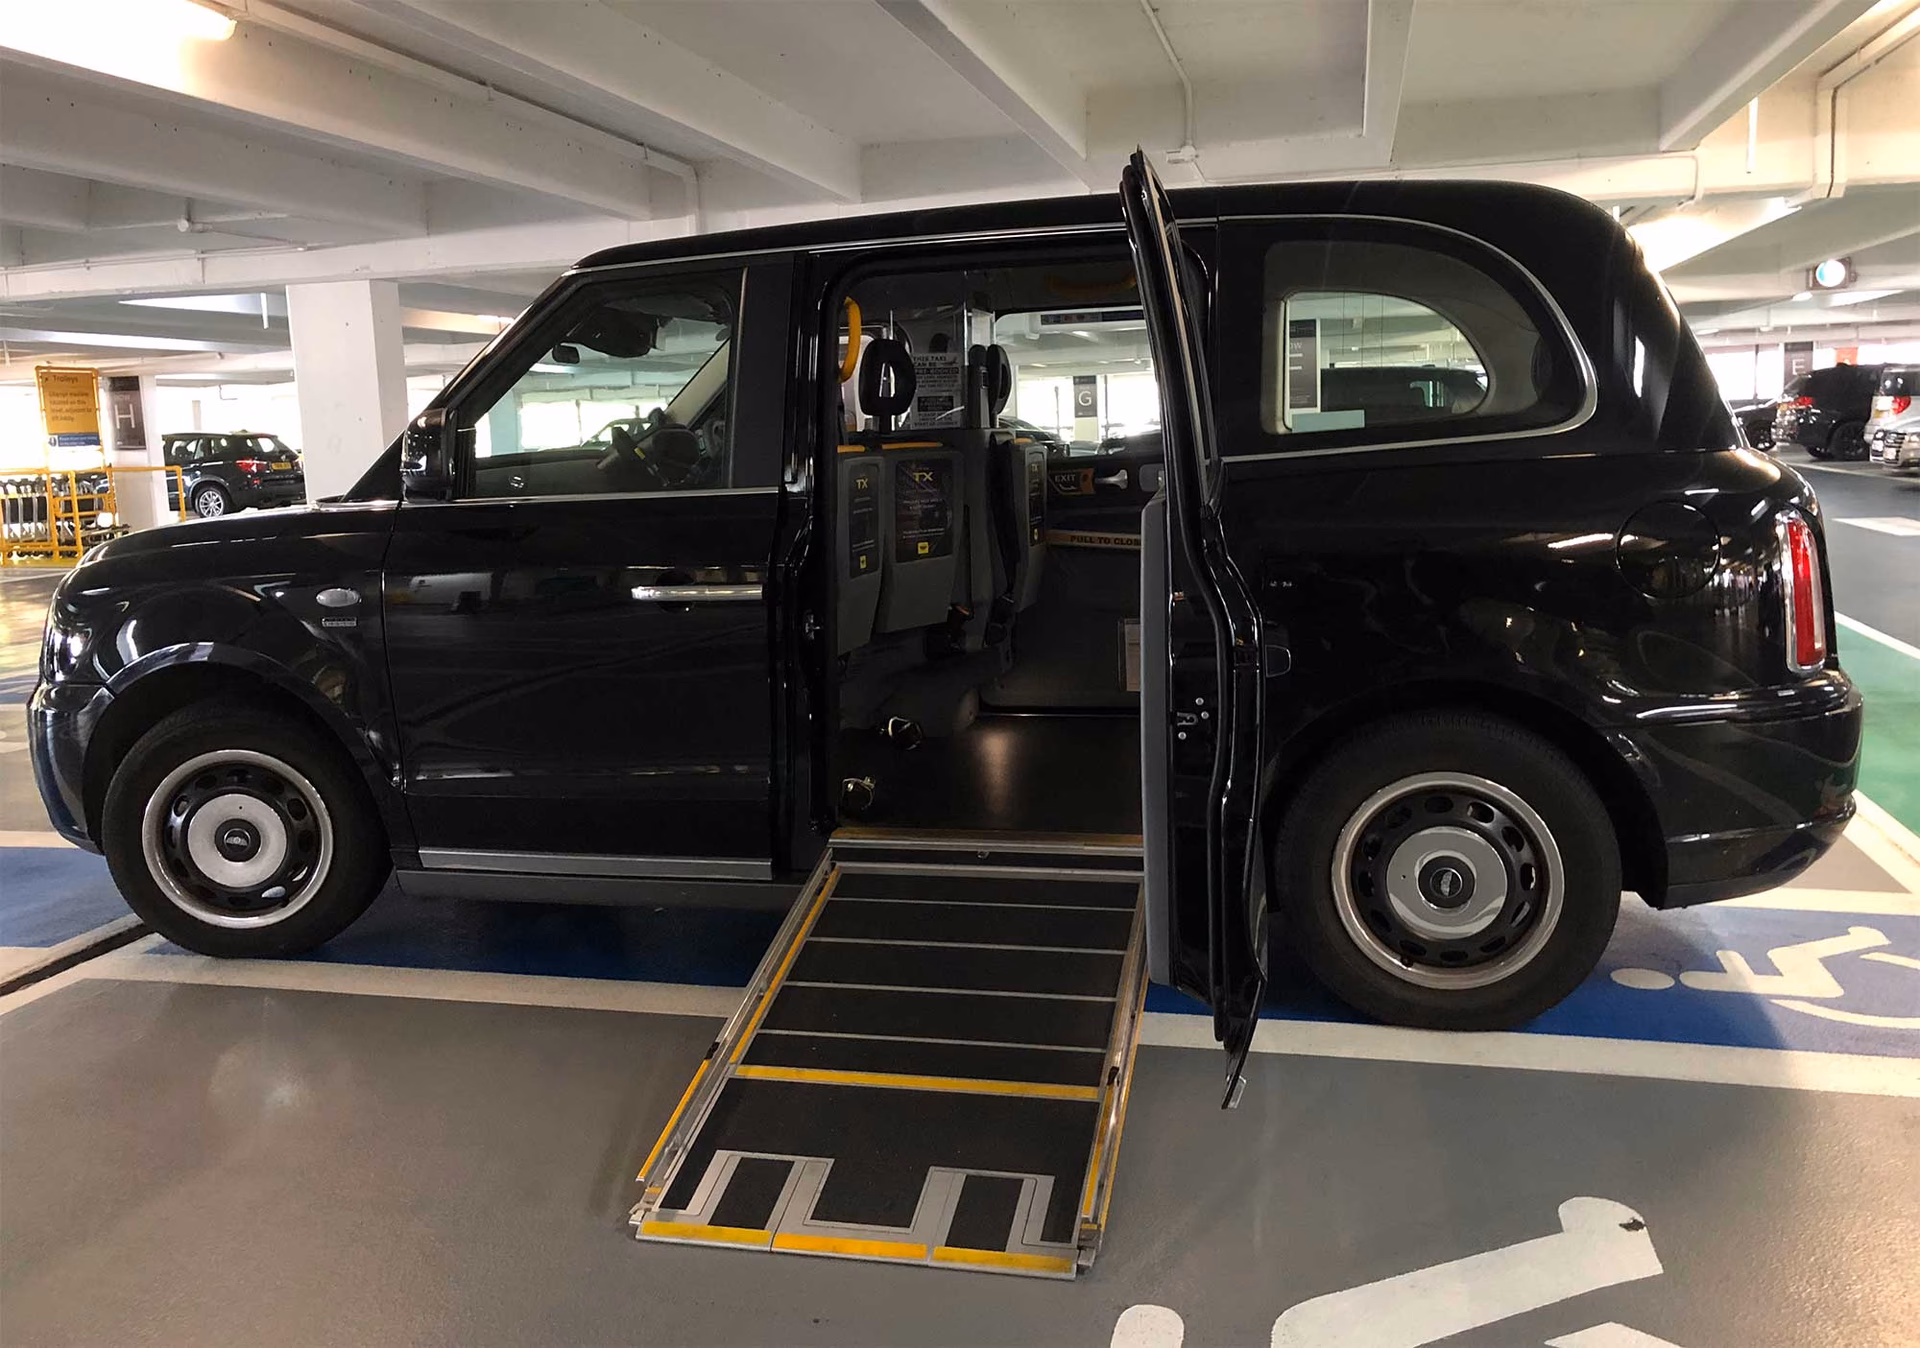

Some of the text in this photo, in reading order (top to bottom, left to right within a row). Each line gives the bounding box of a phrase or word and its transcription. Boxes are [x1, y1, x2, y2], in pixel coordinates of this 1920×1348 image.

[53, 375, 79, 384] Trolleys
[1078, 390, 1092, 406] G
[114, 403, 135, 429] H
[912, 471, 934, 482] TX
[1054, 474, 1076, 482] EXIT
[856, 478, 868, 489] TX
[1070, 535, 1095, 543] PULL
[1113, 537, 1140, 546] CLOS
